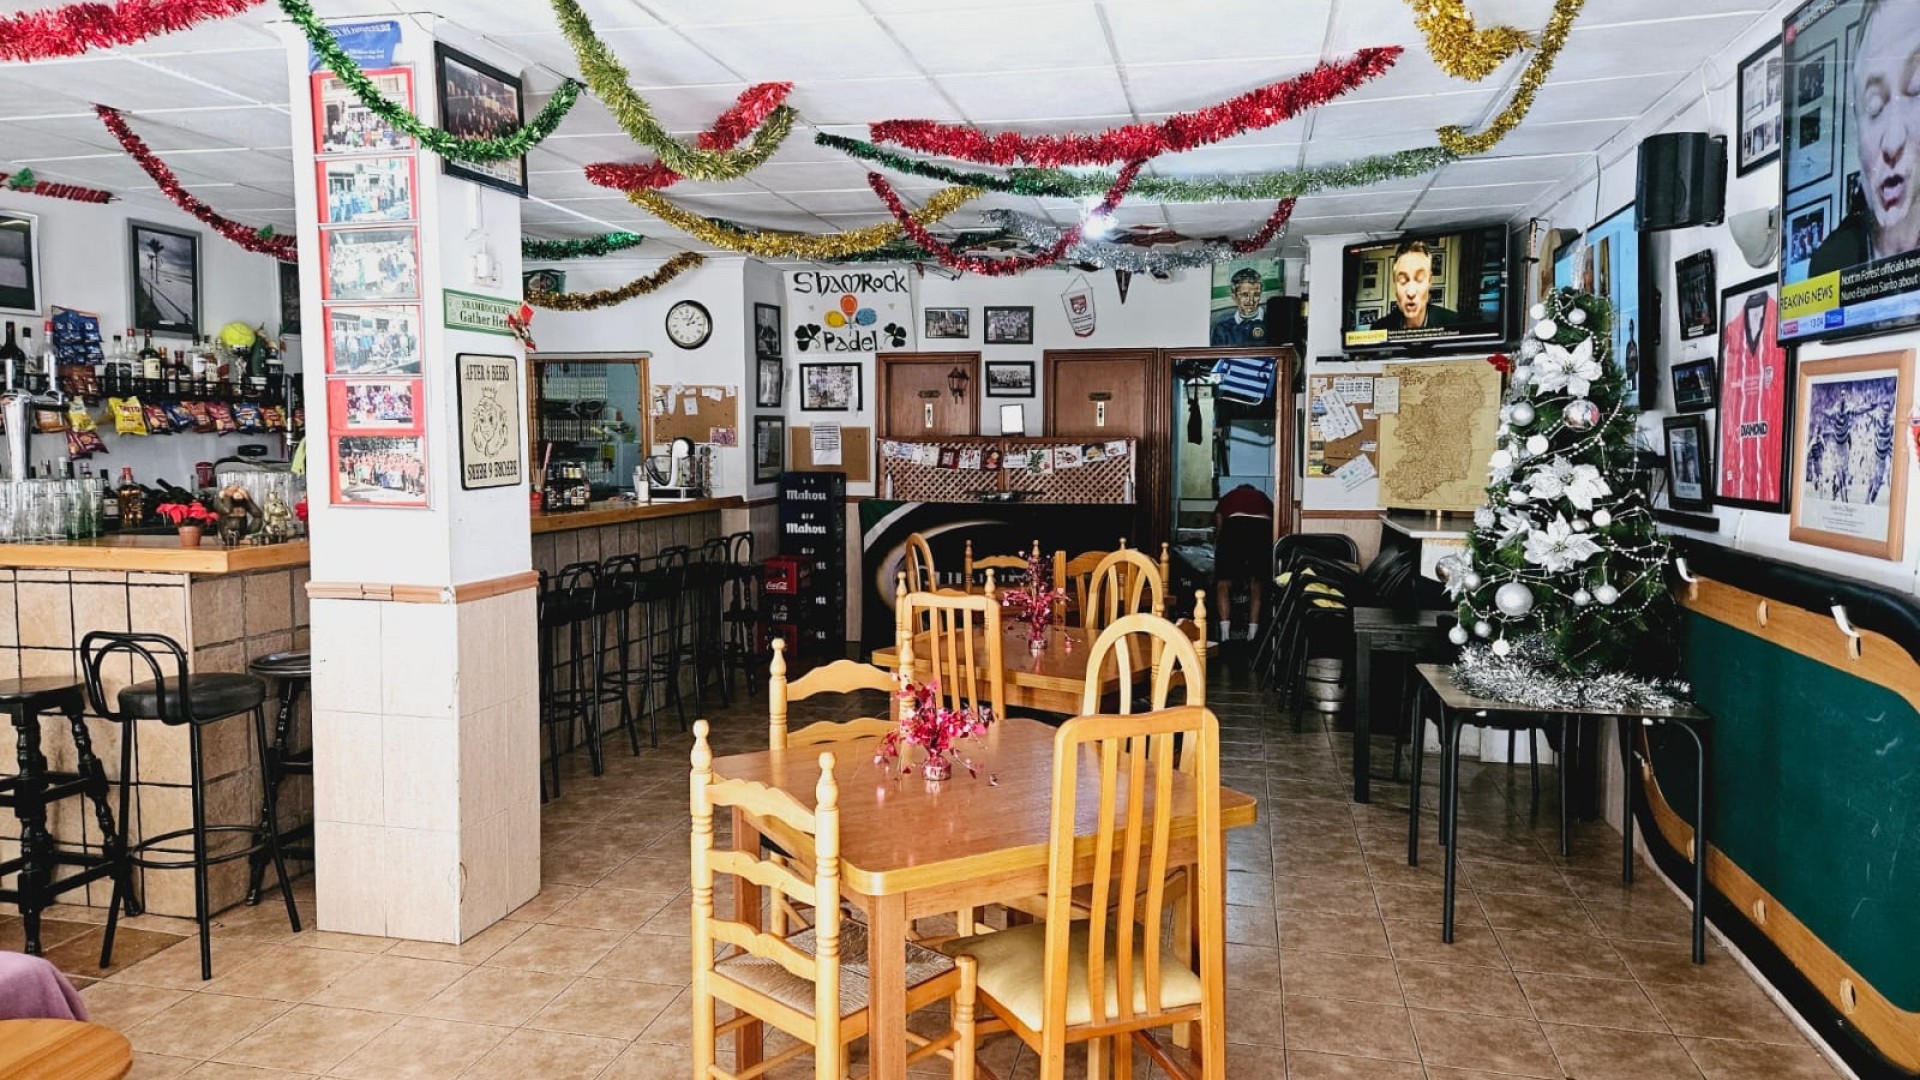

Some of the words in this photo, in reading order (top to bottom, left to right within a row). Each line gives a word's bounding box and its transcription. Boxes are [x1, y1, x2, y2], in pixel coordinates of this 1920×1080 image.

[36, 182, 108, 203] NAVIDAD
[1861, 268, 1880, 282] Forest
[1812, 286, 1833, 302] NEWS
[460, 310, 490, 325] Gather
[466, 365, 485, 380] AFTER
[492, 365, 509, 380] BEERS
[1740, 422, 1768, 436] DIAMOND
[467, 463, 487, 480] BEERS
[494, 460, 517, 477] BEFORE
[786, 490, 826, 501] Mahou
[786, 523, 826, 534] Mahou
